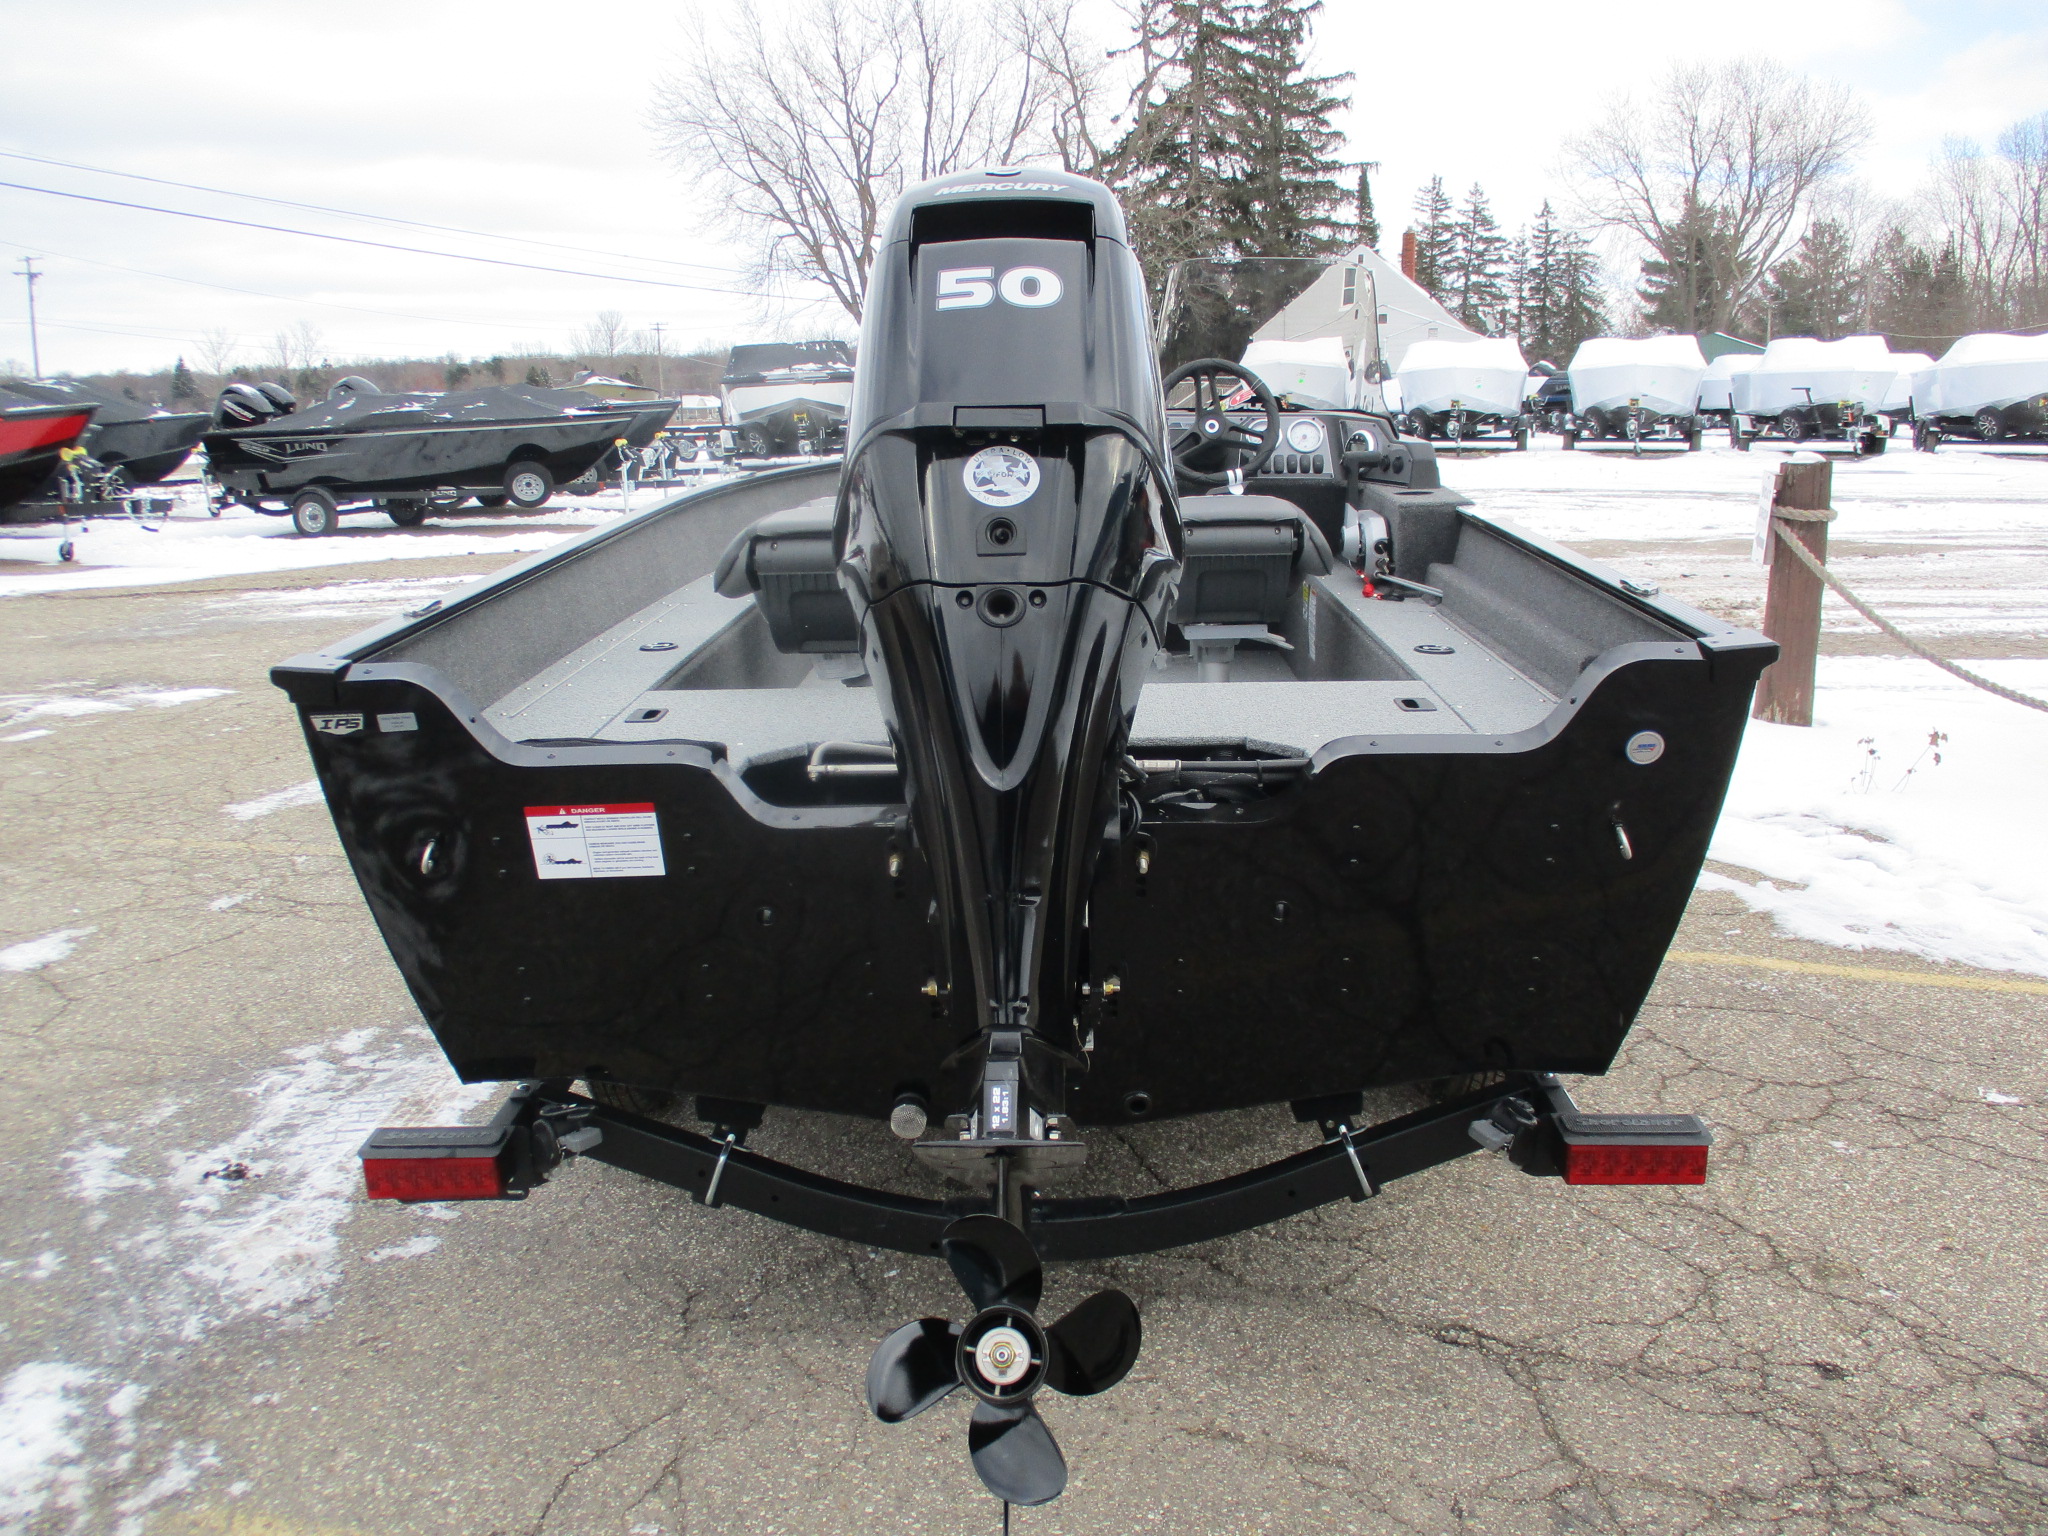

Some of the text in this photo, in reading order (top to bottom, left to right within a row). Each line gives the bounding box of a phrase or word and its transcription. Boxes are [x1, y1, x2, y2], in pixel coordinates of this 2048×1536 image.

[934, 182, 1070, 197] MERCURY
[936, 265, 1064, 311] 50
[285, 442, 329, 455] LUND
[1012, 449, 1033, 464] LOW
[320, 718, 362, 730] IPS
